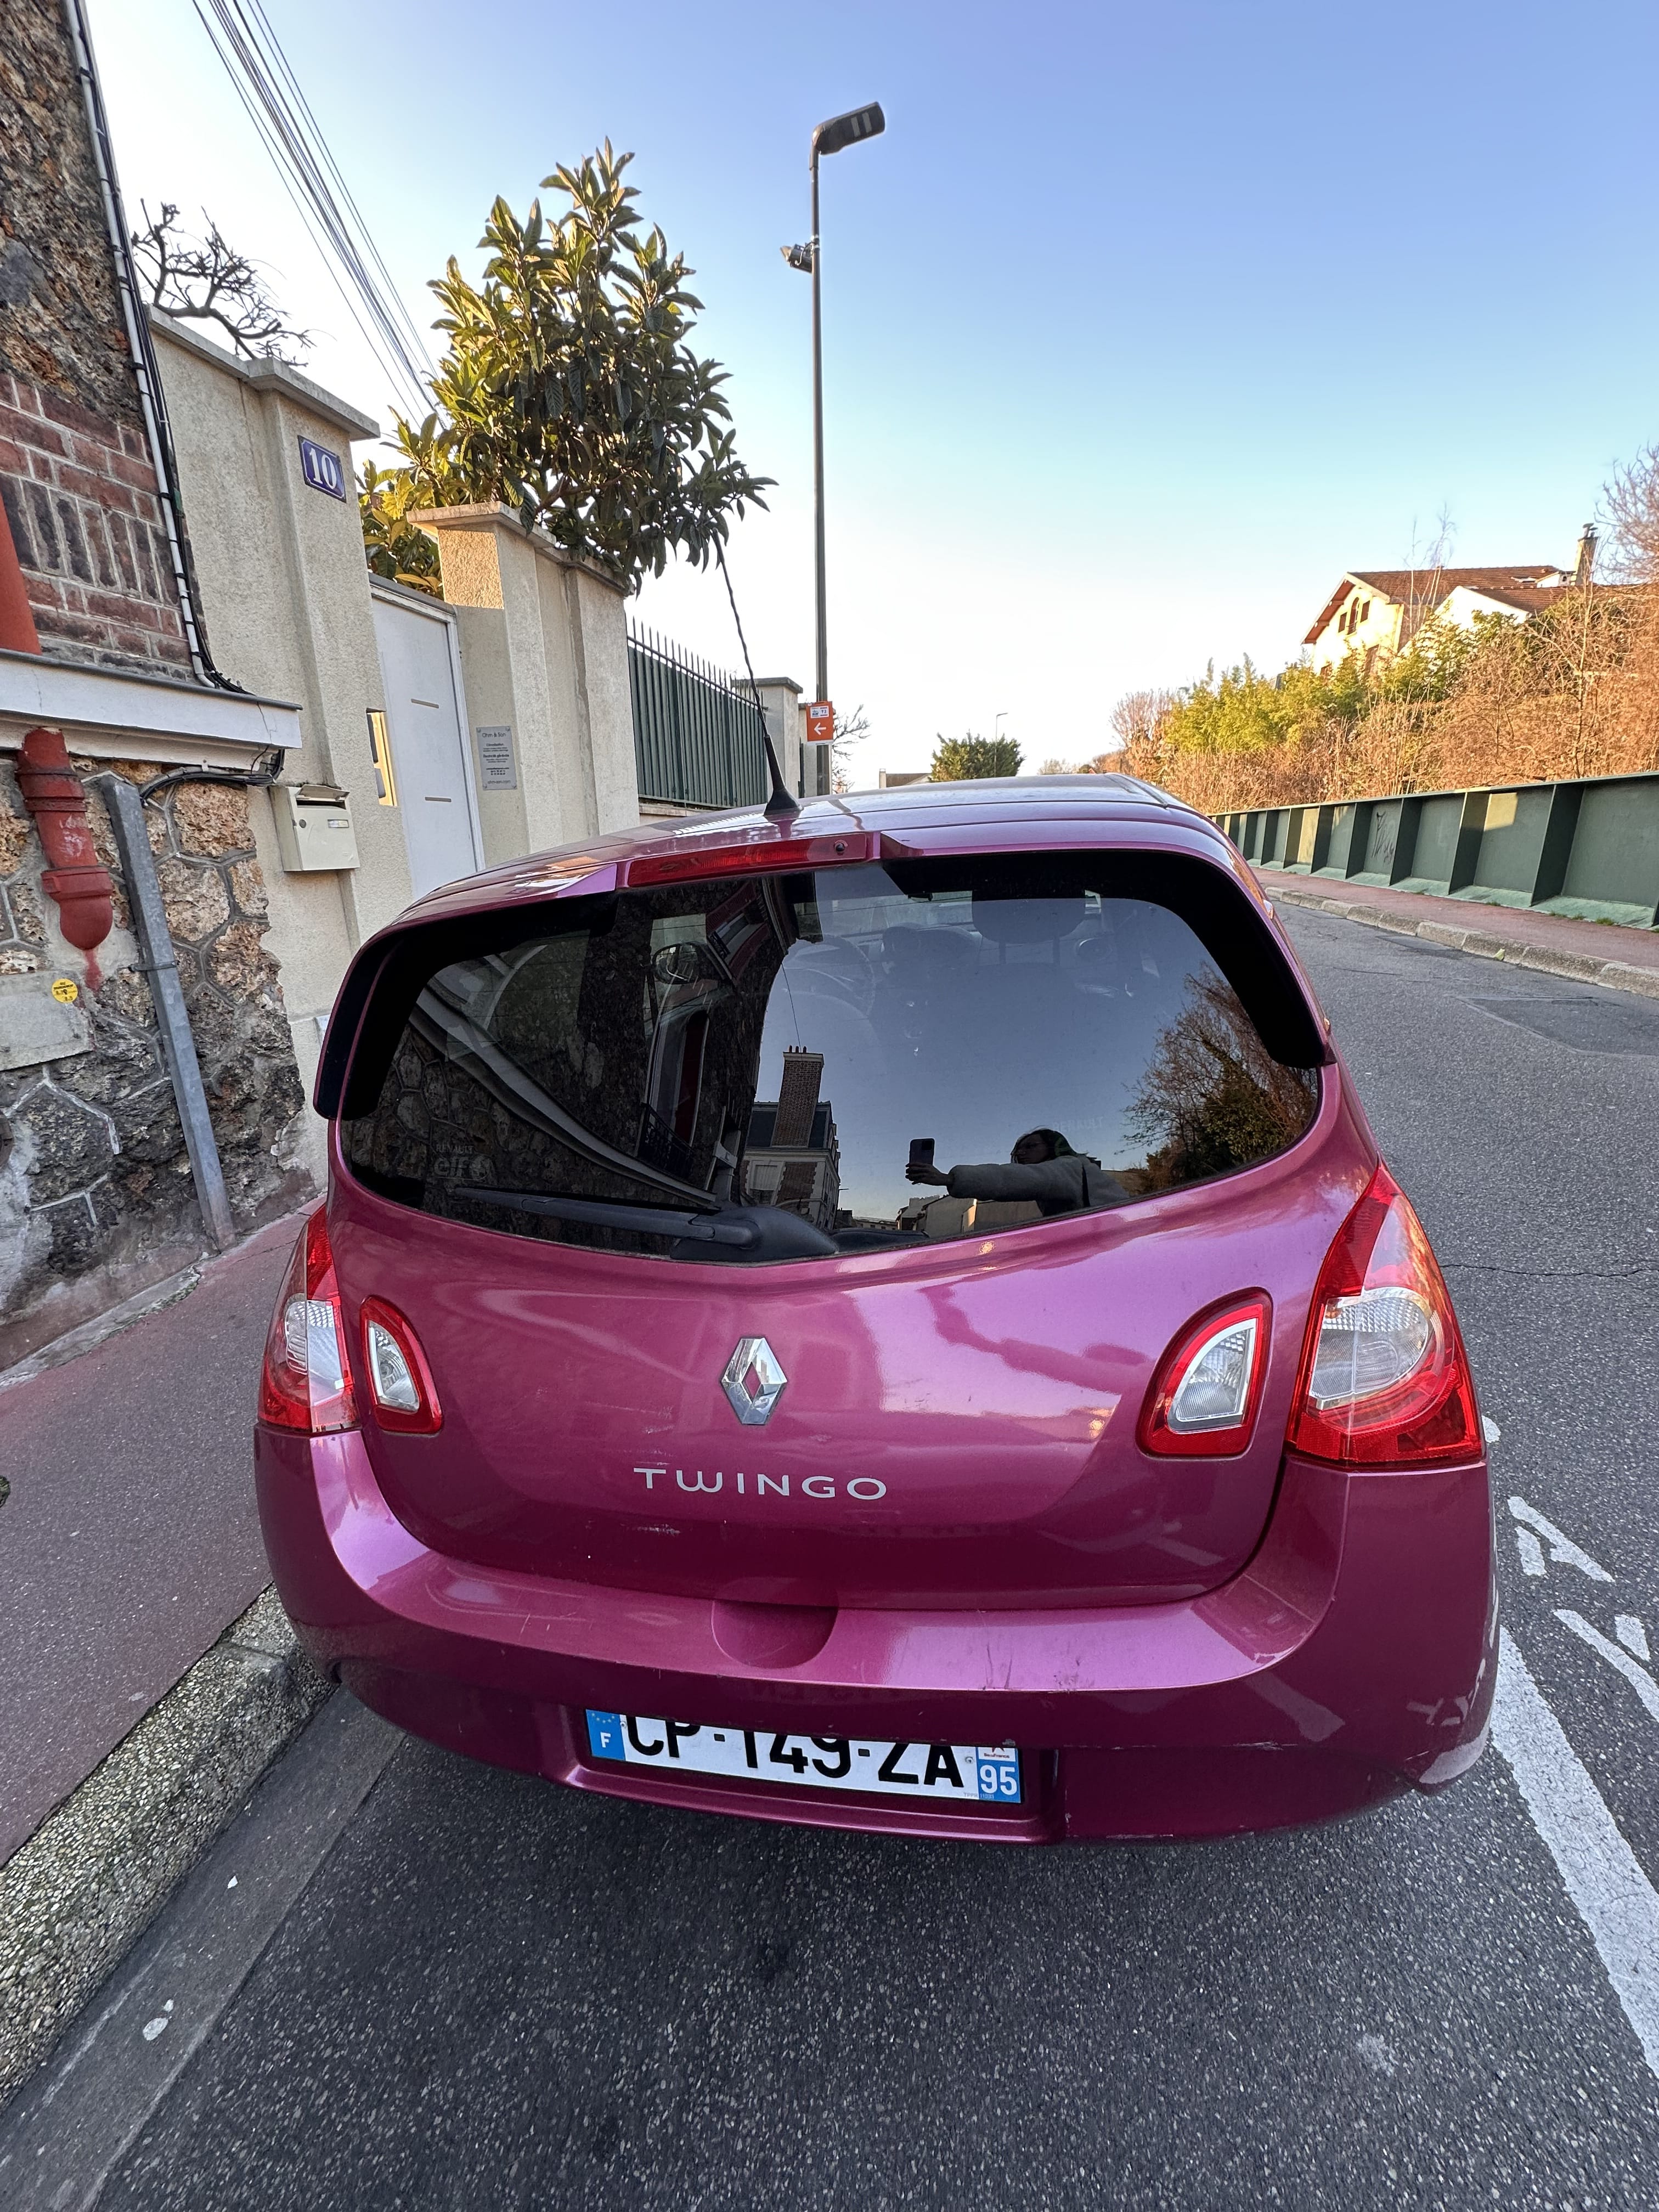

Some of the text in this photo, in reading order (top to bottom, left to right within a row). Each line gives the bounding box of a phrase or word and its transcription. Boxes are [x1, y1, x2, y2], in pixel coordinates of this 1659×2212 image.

[309, 447, 337, 490] 10
[633, 1467, 887, 1500] TWINGO
[600, 1732, 611, 1748] F
[980, 1764, 1017, 1796] 95
